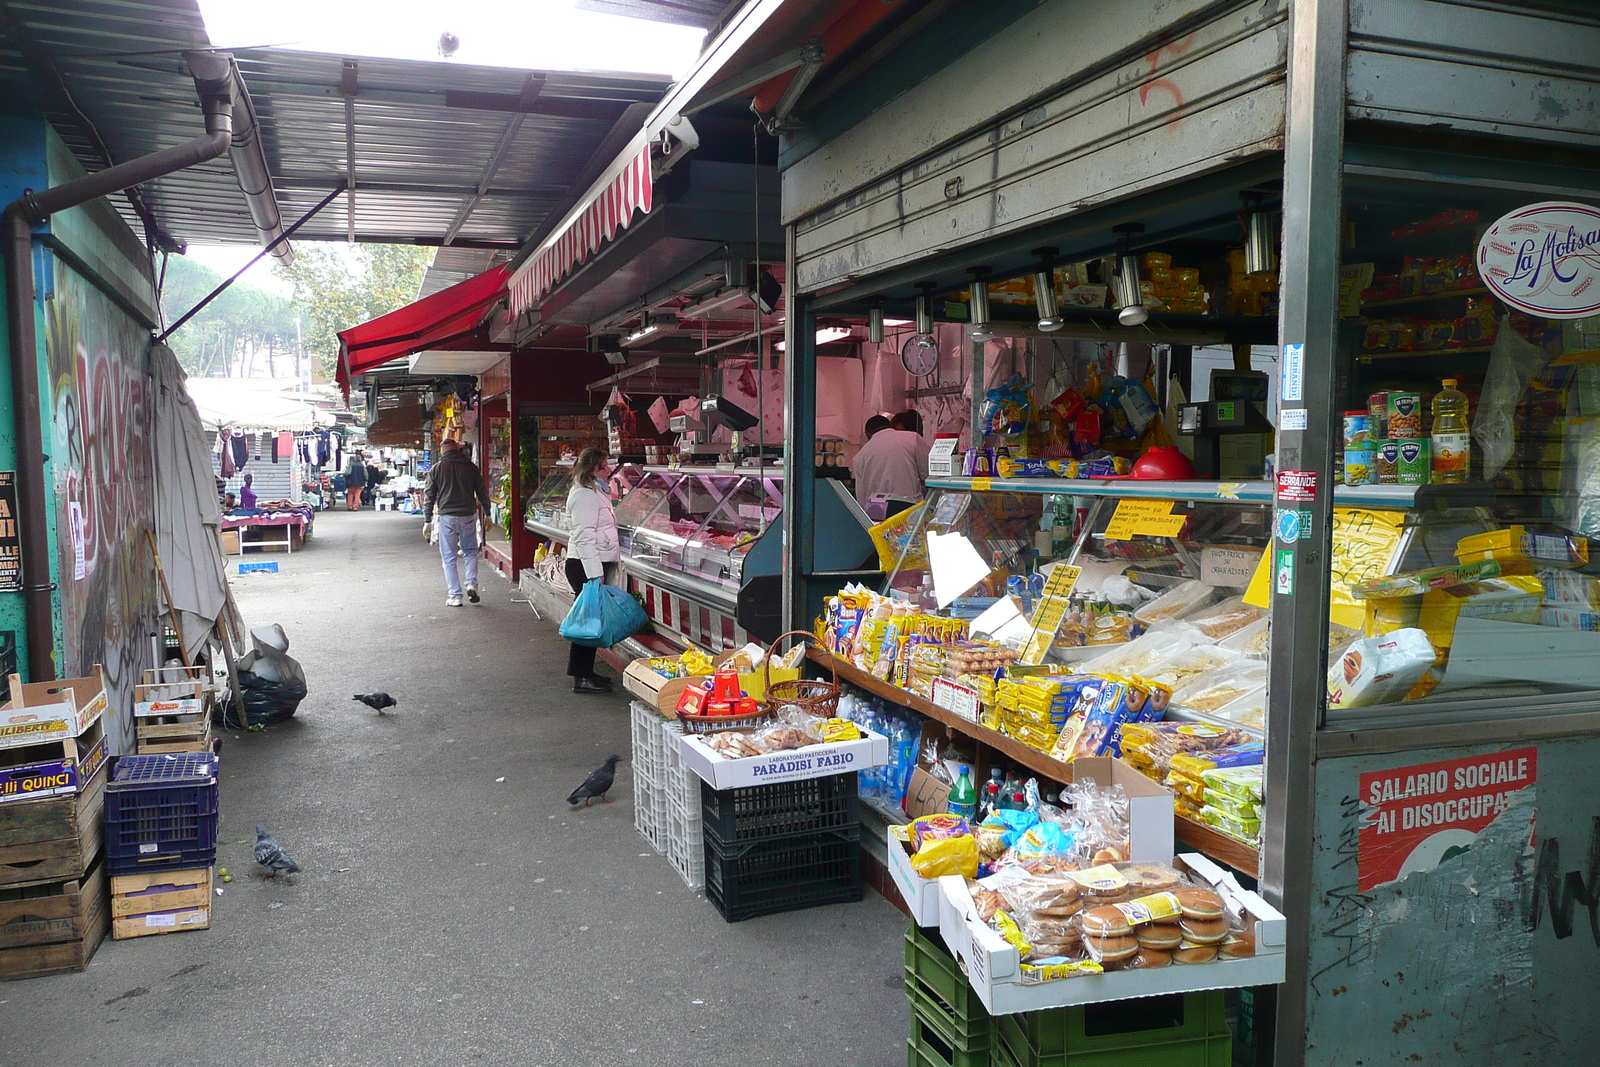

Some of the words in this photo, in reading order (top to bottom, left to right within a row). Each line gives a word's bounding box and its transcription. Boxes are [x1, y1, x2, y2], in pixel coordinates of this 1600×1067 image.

[1527, 225, 1600, 288] Molisa
[1280, 476, 1317, 487] SERRANDE
[752, 760, 812, 777] PARADISI
[816, 752, 854, 767] FABIO
[804, 749, 837, 759] PASTICCERIA
[22, 773, 69, 791] QUINCI
[1369, 770, 1448, 805] SALARIO
[1453, 757, 1528, 791] SOCIALE
[1377, 809, 1396, 835] AI
[1402, 788, 1522, 831] DISOCCUPAT
